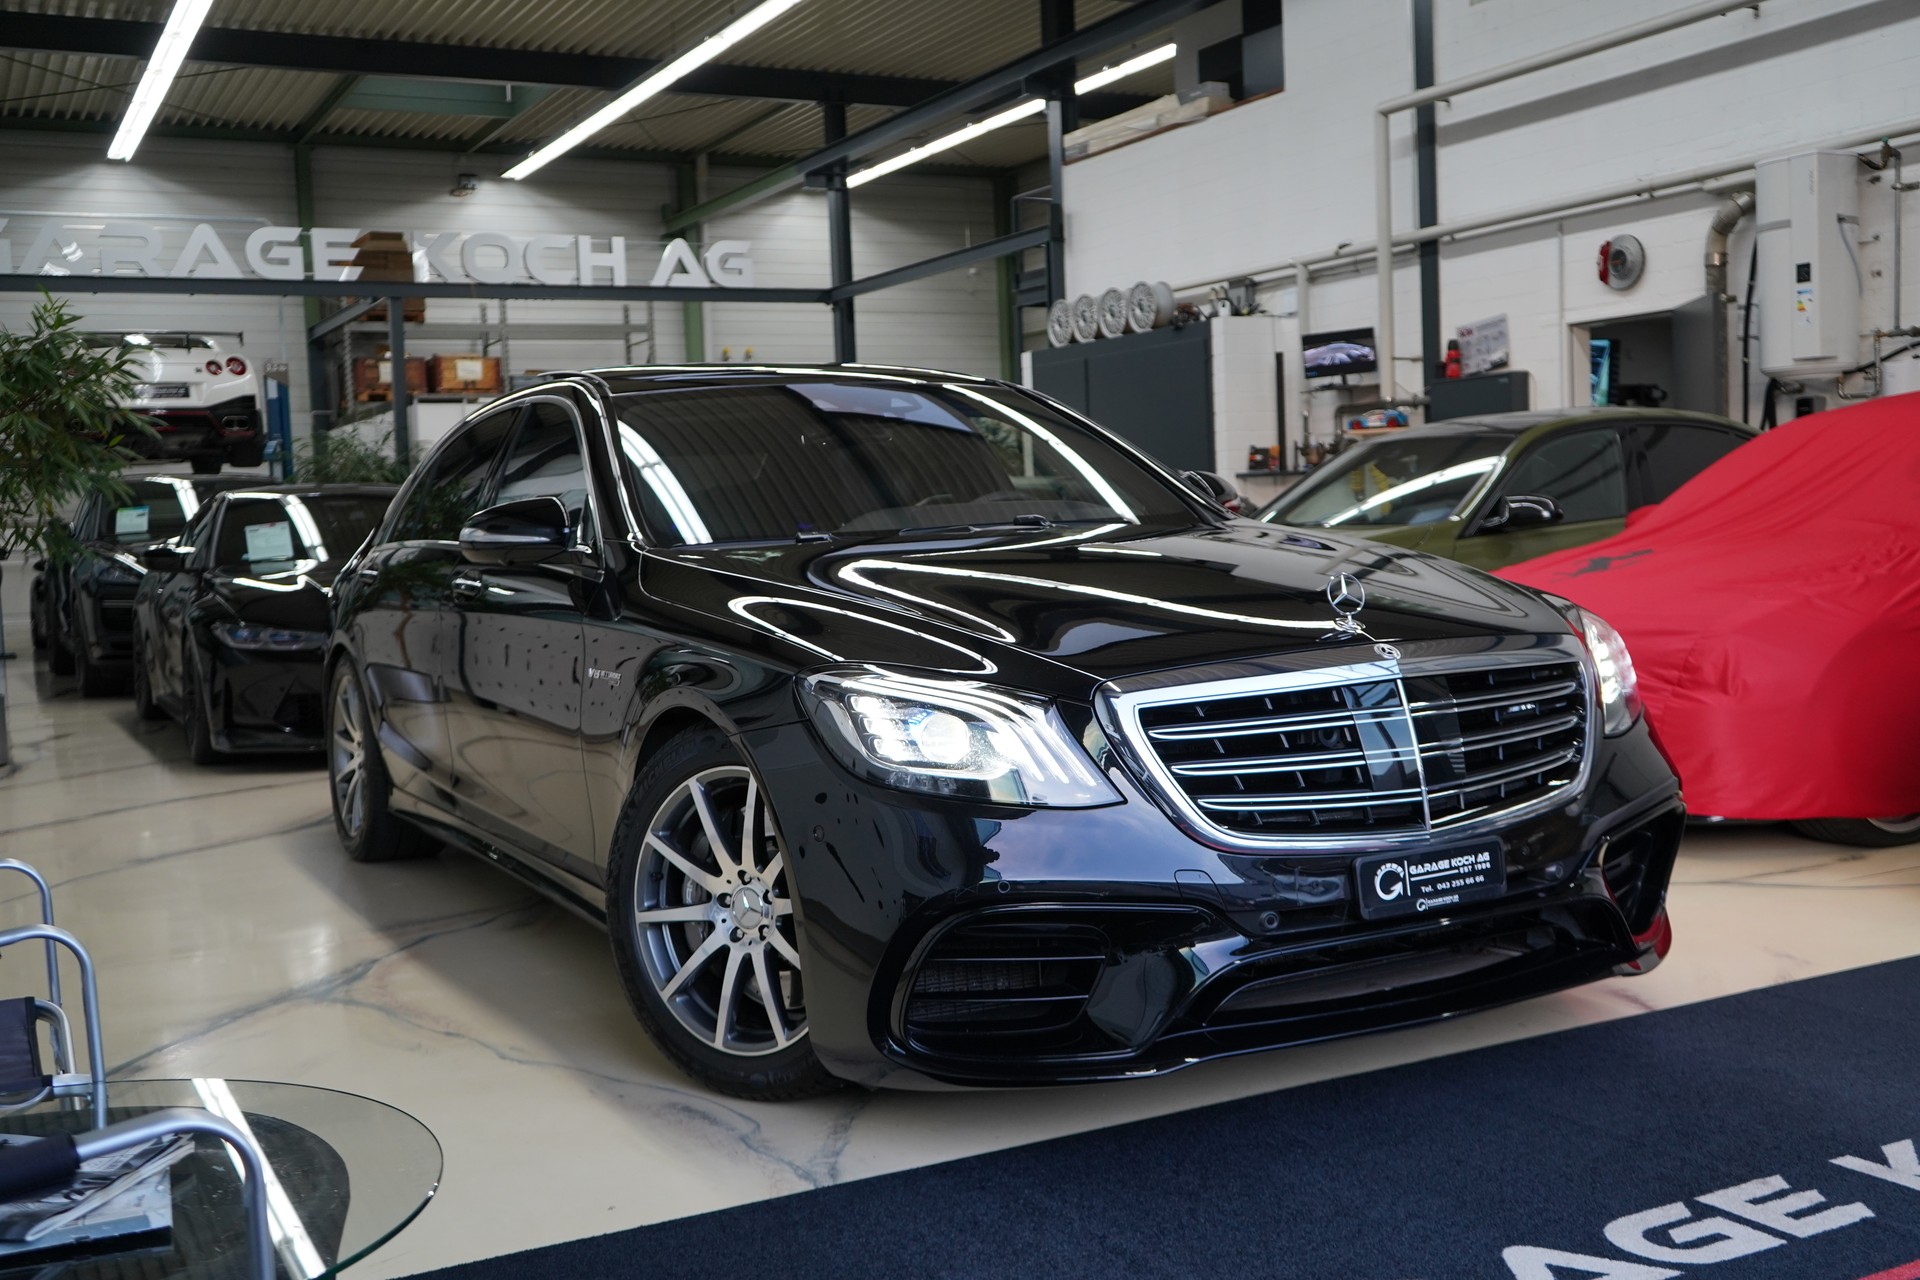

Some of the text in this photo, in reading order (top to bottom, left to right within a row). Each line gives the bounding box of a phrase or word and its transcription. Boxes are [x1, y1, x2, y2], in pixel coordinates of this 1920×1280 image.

[0, 217, 754, 288] ARAGE KOCH AG
[1409, 851, 1491, 875] GARAGE KOCH AG
[1459, 865, 1473, 874] EST
[1420, 884, 1434, 894] Tel.
[1436, 881, 1451, 891] 043
[1465, 876, 1475, 886] 66
[1475, 874, 1485, 884] 66
